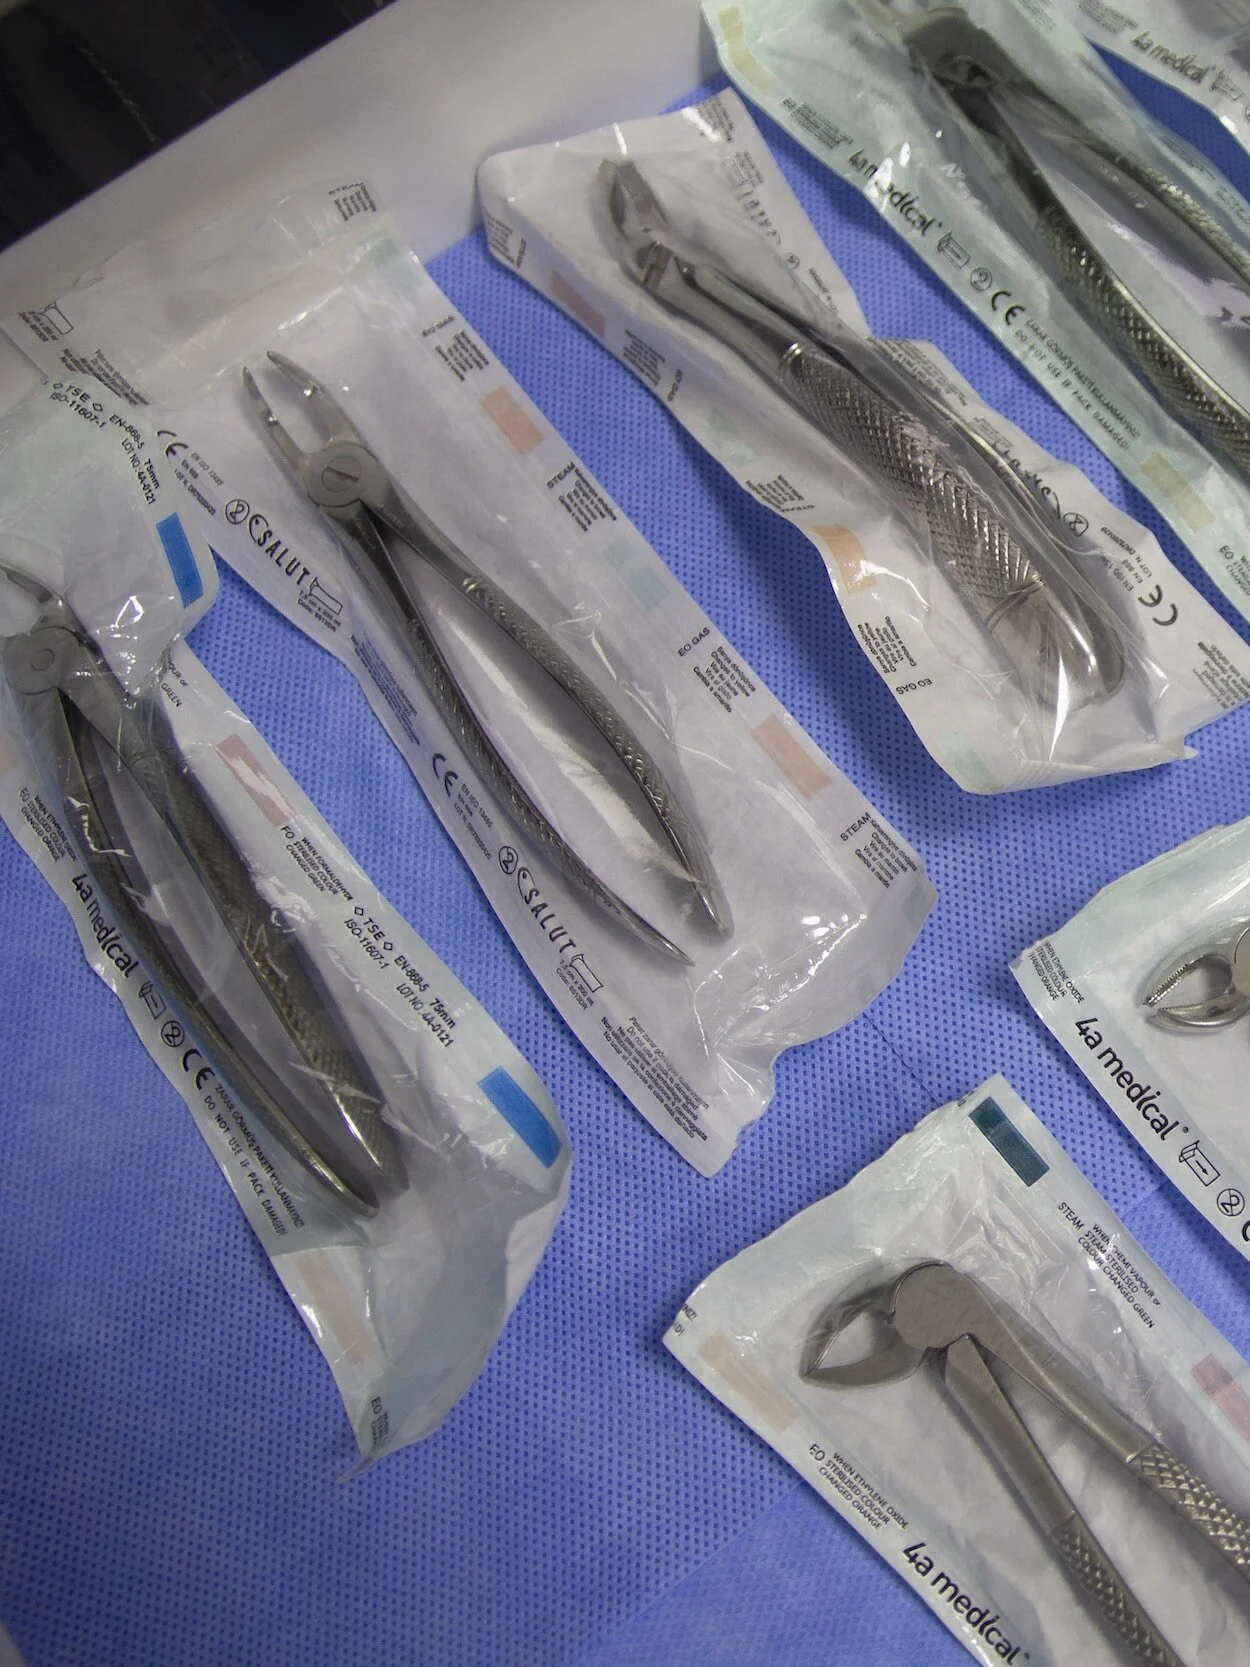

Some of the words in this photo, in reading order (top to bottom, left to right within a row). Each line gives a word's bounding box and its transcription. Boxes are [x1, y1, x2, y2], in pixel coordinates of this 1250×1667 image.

[48, 391, 107, 429] ISO-11607-1
[64, 384, 92, 404] TSE
[108, 413, 146, 451] EN-868-5
[143, 457, 161, 490] 75mm
[252, 528, 311, 587] SALUT
[1218, 544, 1235, 561] EO
[677, 642, 693, 658] EO
[690, 626, 711, 646] GAS
[160, 681, 183, 708] GREEN
[894, 682, 918, 696] GAS
[916, 677, 934, 688] EO
[18, 786, 31, 803] EO
[279, 824, 296, 840] FO
[839, 811, 872, 842] STEAM
[71, 872, 94, 904] 4a
[85, 898, 140, 979] medical
[519, 887, 577, 955] SALUT
[343, 917, 391, 970] ISO-11607-1
[395, 982, 416, 999] LOT
[362, 916, 387, 942] TSE
[393, 954, 430, 993] EN-868-5
[428, 997, 457, 1030] 75mm
[1048, 971, 1069, 998] COLOUR
[1051, 955, 1070, 983] ETHYLENE
[1064, 980, 1086, 1005] OXIDE
[1040, 974, 1061, 1002] ORANGE
[1074, 1017, 1104, 1051] 4a
[1096, 1046, 1180, 1142] medical
[203, 1094, 217, 1112] DO
[213, 1112, 232, 1135] NOT
[227, 1136, 244, 1158] USE
[246, 1171, 266, 1198] PACK
[1057, 1201, 1086, 1231] STEAM
[1077, 1236, 1106, 1268] COLOUR
[1101, 1265, 1136, 1304] CHANGED
[1132, 1302, 1156, 1329] GREEN
[1083, 1229, 1108, 1255] STEAM
[1104, 1252, 1140, 1294] STERILISED
[1092, 1223, 1111, 1247] WHEN
[1129, 1266, 1156, 1300] VAPOUR
[808, 1442, 826, 1462] EO
[818, 1466, 854, 1502] CHANGED
[851, 1499, 883, 1530] ORANGE
[824, 1459, 863, 1497] STERILISED
[859, 1494, 891, 1526] COLOUR
[832, 1451, 857, 1477] WHEN
[852, 1473, 889, 1510] ETHYLENE
[885, 1505, 910, 1530] OXIDE
[902, 1541, 935, 1578] 4a
[929, 1571, 1021, 1666] medical
